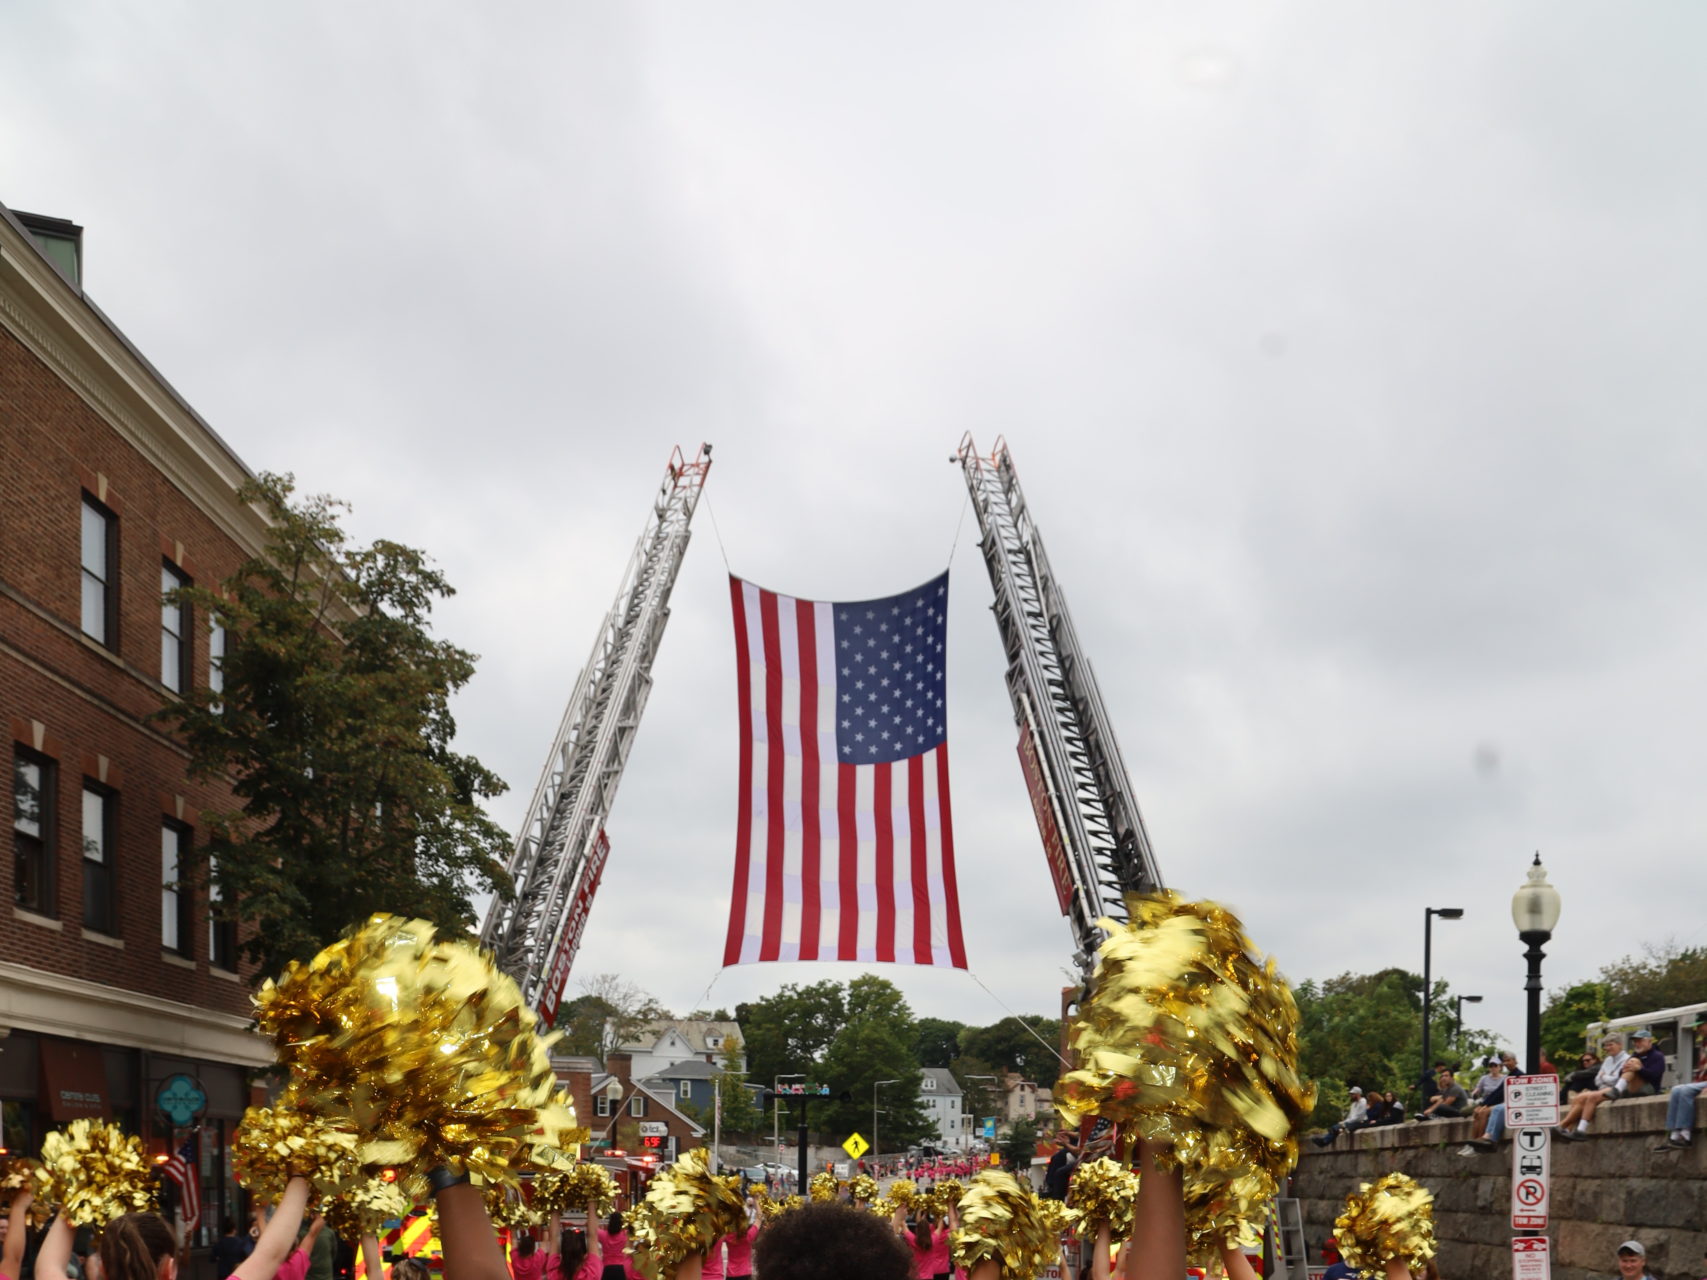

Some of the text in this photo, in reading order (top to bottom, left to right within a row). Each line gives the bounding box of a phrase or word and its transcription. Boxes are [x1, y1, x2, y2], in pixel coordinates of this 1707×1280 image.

[545, 840, 606, 1015] BOSTON FIRE
[567, 912, 587, 969] LADDER
[1531, 1075, 1554, 1084] ZONE
[1514, 1215, 1545, 1224] TOW ZONE
[1038, 1270, 1062, 1279] STO
